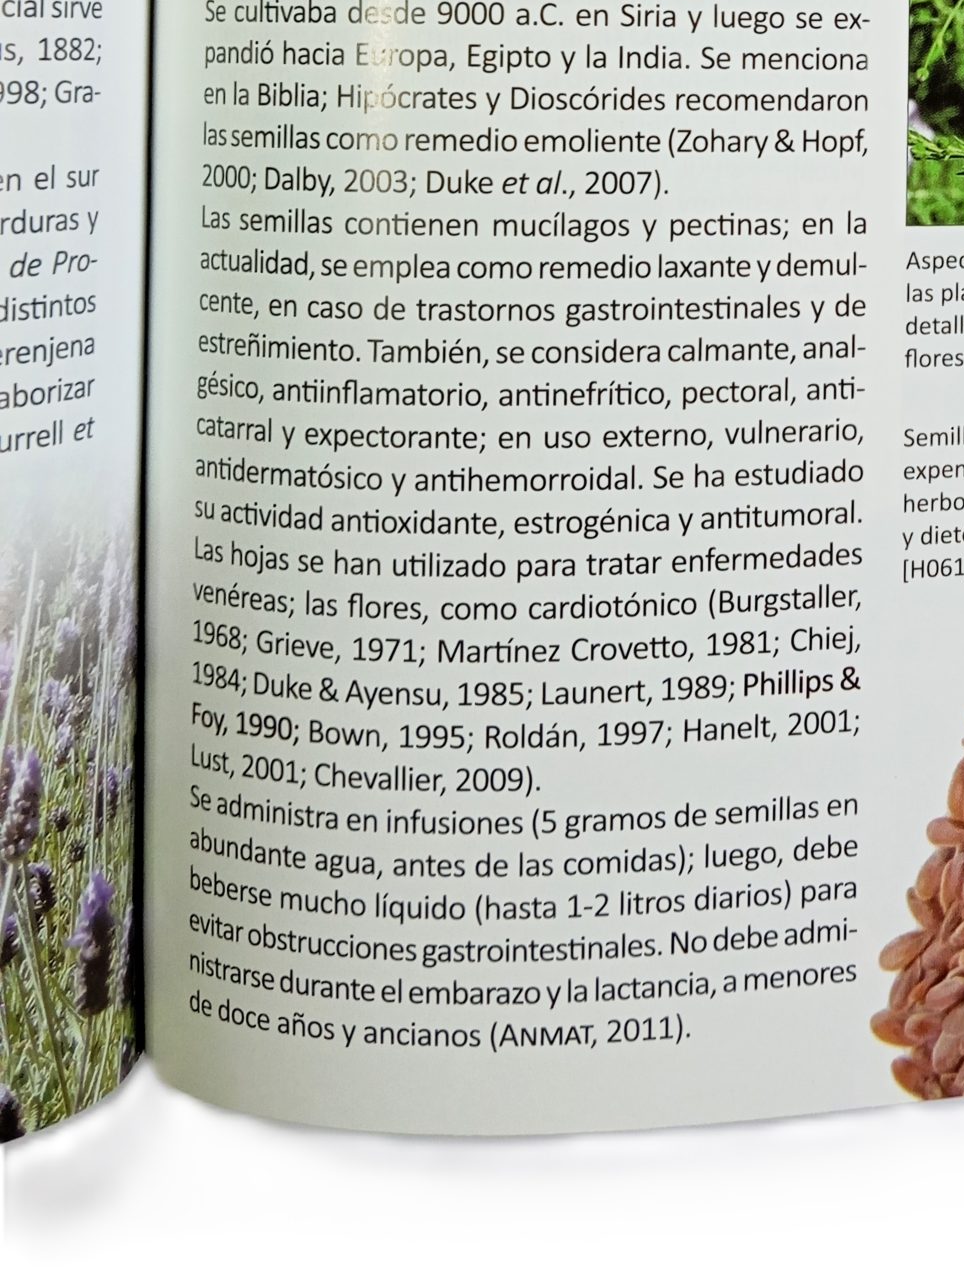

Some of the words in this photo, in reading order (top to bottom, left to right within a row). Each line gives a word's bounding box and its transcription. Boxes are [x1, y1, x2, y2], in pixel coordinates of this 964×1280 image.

[202, 163, 256, 194] 2000;
[265, 166, 335, 198] Dalby,
[344, 168, 416, 199] 2003;
[427, 169, 494, 194] Duke
[502, 172, 530, 195] et
[536, 169, 575, 200] al.,
[585, 169, 668, 200] 2007).
[87, 211, 99, 235] y
[9, 251, 42, 278] de
[52, 250, 98, 275] Pro-
[907, 282, 934, 303] las
[198, 332, 361, 362] estreñimiento.
[367, 338, 489, 369] También,
[496, 346, 525, 364] se
[531, 338, 661, 364] considera
[668, 337, 796, 365] calmante,
[803, 333, 866, 360] anal-
[197, 370, 264, 405] gésico,
[272, 378, 488, 411] antiinflamatorio,
[499, 380, 671, 410] antinefrítico,
[682, 376, 796, 410] pectoral,
[807, 376, 865, 401] anti-
[194, 500, 215, 520] su
[221, 501, 323, 531] actividad
[331, 509, 504, 540] antioxidante,
[514, 507, 670, 540] estrogénica
[678, 513, 694, 537] y
[701, 499, 862, 530] antitumoral.
[902, 531, 914, 551] y
[193, 619, 248, 656] 1968;
[256, 629, 341, 665] Grieve,
[353, 637, 425, 668] 1971;
[438, 637, 560, 664] Martínez
[571, 636, 694, 663] Crovetto,
[707, 630, 779, 658] 1981;
[791, 625, 861, 655] Chiej,
[189, 913, 244, 944] evitar
[248, 923, 417, 962] obstrucciones
[422, 932, 662, 969] gastrointestinales.
[671, 930, 707, 955] No
[713, 924, 779, 952] debe
[784, 917, 857, 947] admi-
[189, 989, 212, 1017] de
[218, 998, 270, 1031] doce
[277, 1012, 335, 1040] años
[341, 1024, 356, 1048] y
[363, 1022, 481, 1048] ancianos
[490, 1021, 597, 1053] (ANMAT,
[607, 1013, 690, 1045] 2011).
